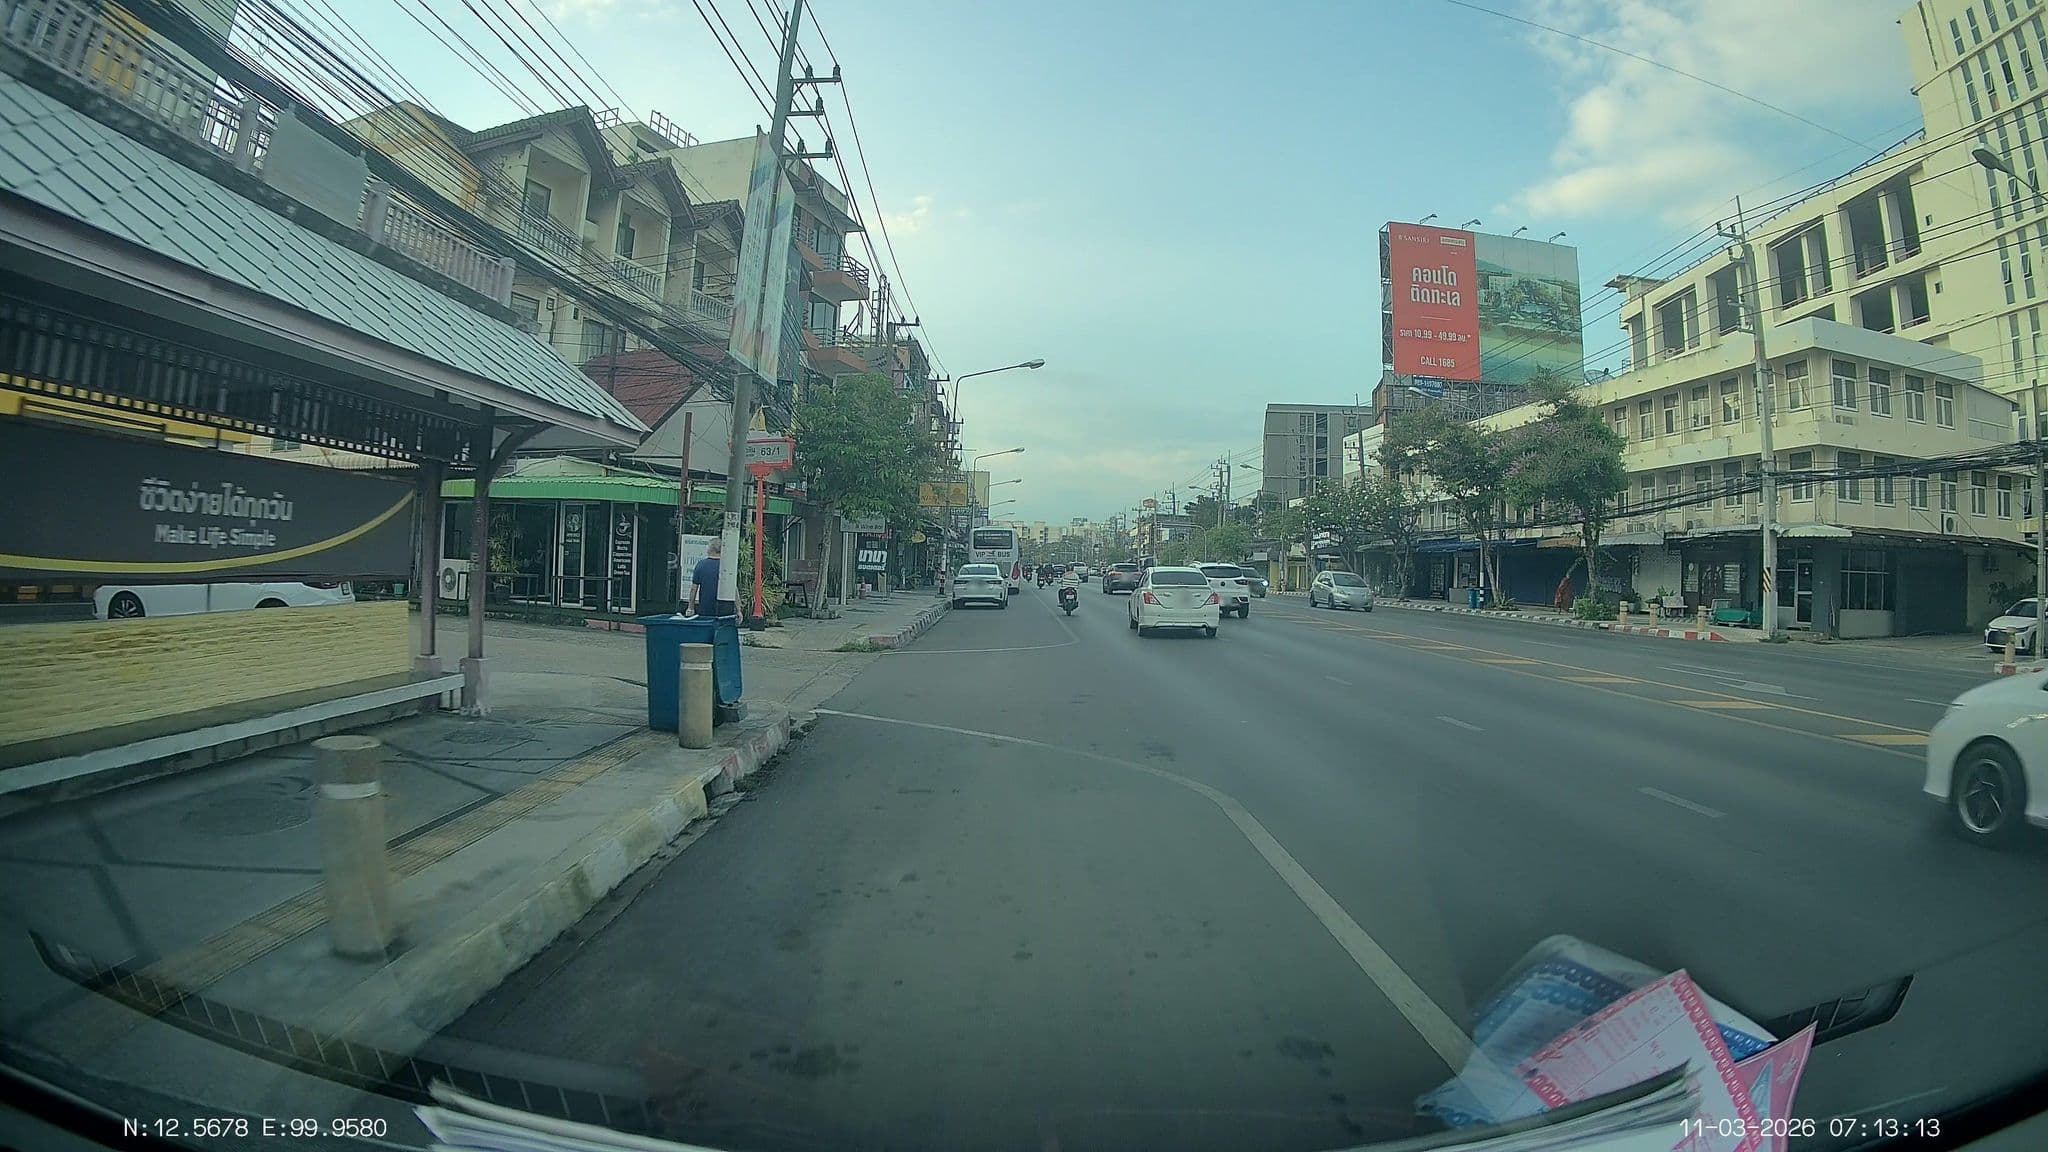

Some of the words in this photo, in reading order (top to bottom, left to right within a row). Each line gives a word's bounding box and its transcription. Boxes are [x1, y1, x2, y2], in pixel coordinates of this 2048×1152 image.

[1403, 235, 1430, 244] SANSIRI
[1412, 265, 1458, 287] คอนโด
[1410, 284, 1461, 307] ติดทะเล
[1414, 329, 1433, 339] 10.99
[1438, 331, 1457, 341] 49.99
[1420, 356, 1437, 367] CALL
[1439, 358, 1455, 368] 1685
[760, 447, 780, 456] 63/1
[138, 476, 294, 527] ชีวิตง่ายได้ทุกวัน
[154, 523, 198, 544] Make
[198, 526, 228, 549] Life
[229, 527, 278, 550] Simple
